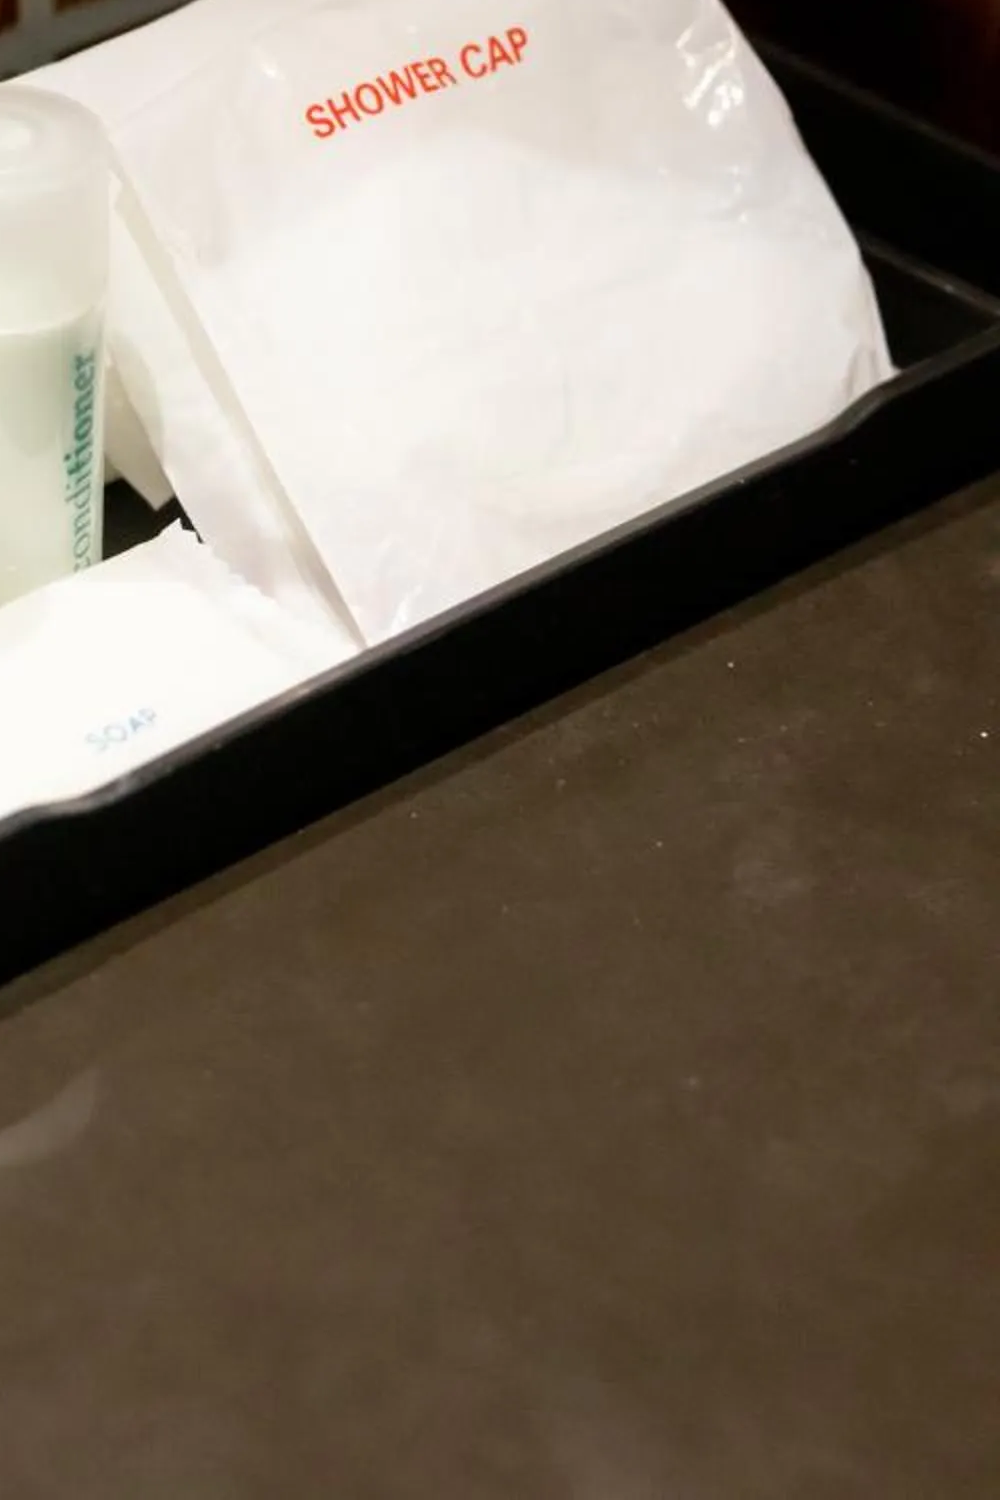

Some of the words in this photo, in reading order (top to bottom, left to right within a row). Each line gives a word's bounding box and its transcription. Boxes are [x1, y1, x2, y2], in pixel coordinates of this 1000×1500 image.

[305, 57, 457, 138] SHOWER
[459, 27, 528, 79] CAP
[83, 706, 158, 754] SOAP
